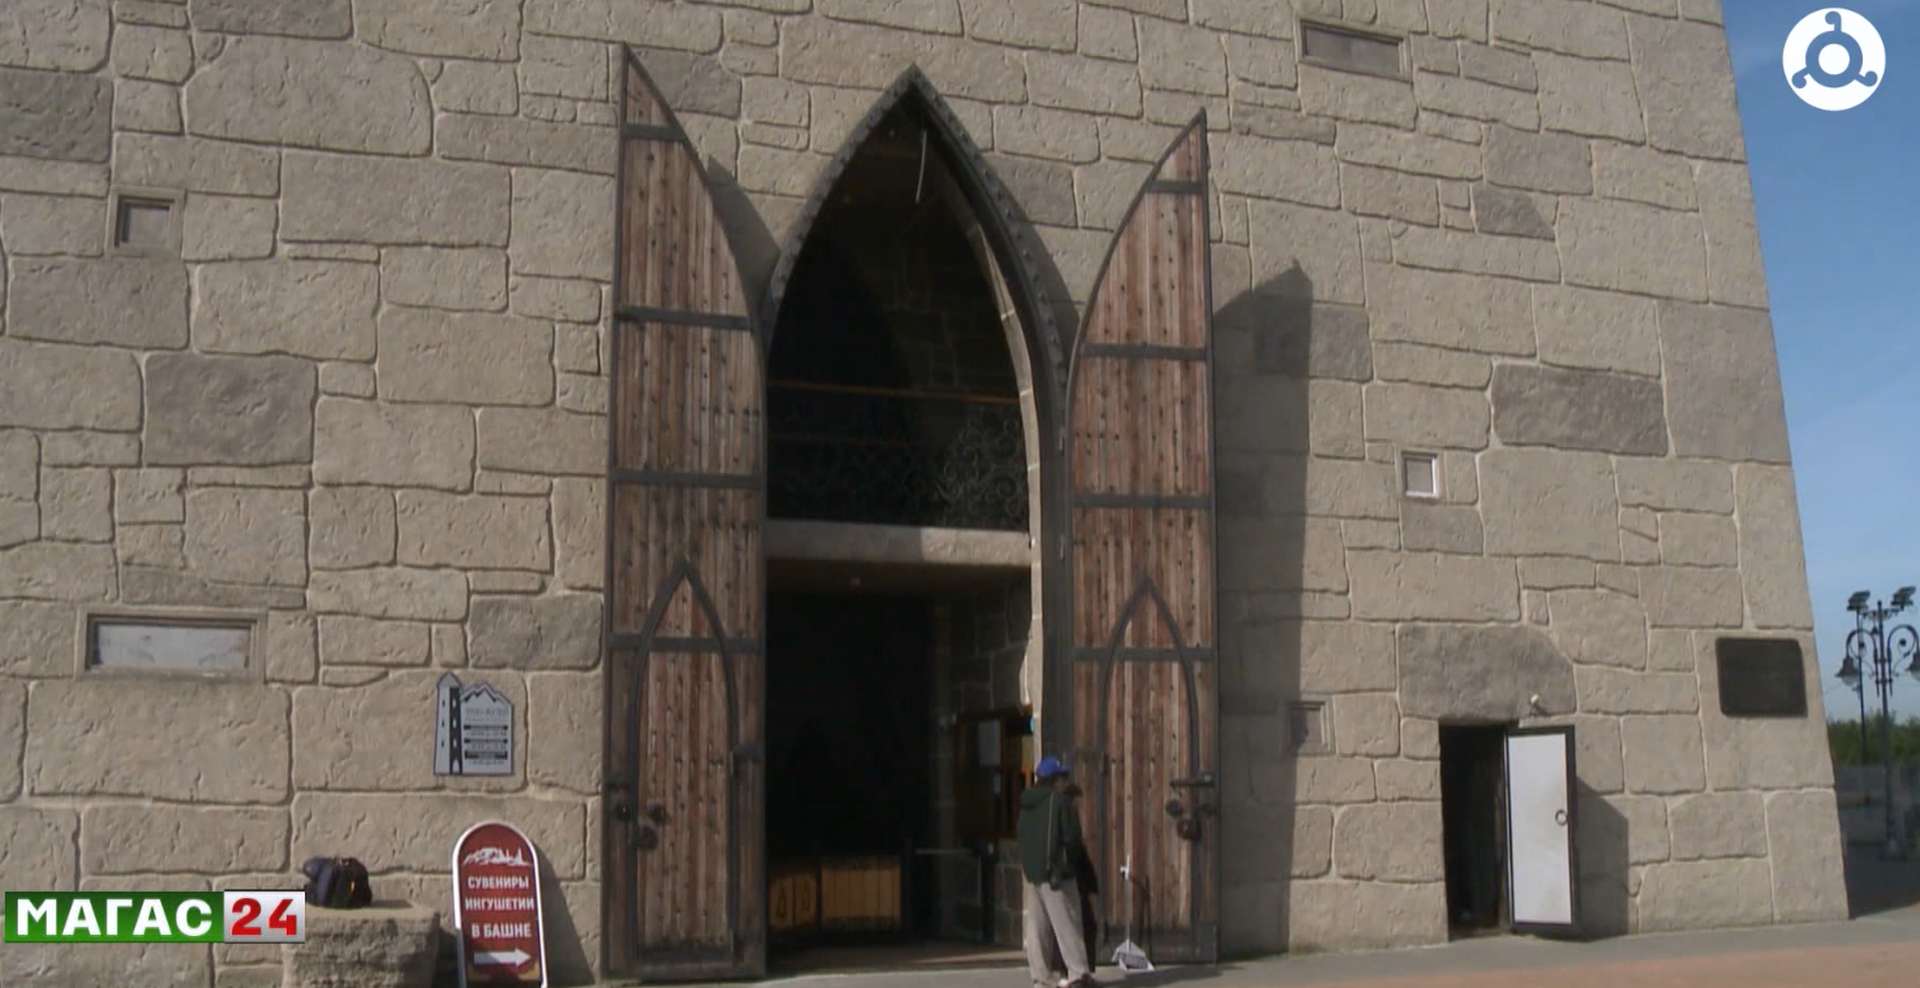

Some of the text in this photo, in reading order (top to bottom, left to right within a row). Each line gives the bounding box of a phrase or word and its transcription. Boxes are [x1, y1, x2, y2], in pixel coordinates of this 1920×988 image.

[468, 876, 529, 889] СУВЕНИРЫ
[465, 898, 535, 911] ИНГУШЕТИИ
[472, 922, 532, 938] В БАШНЕ
